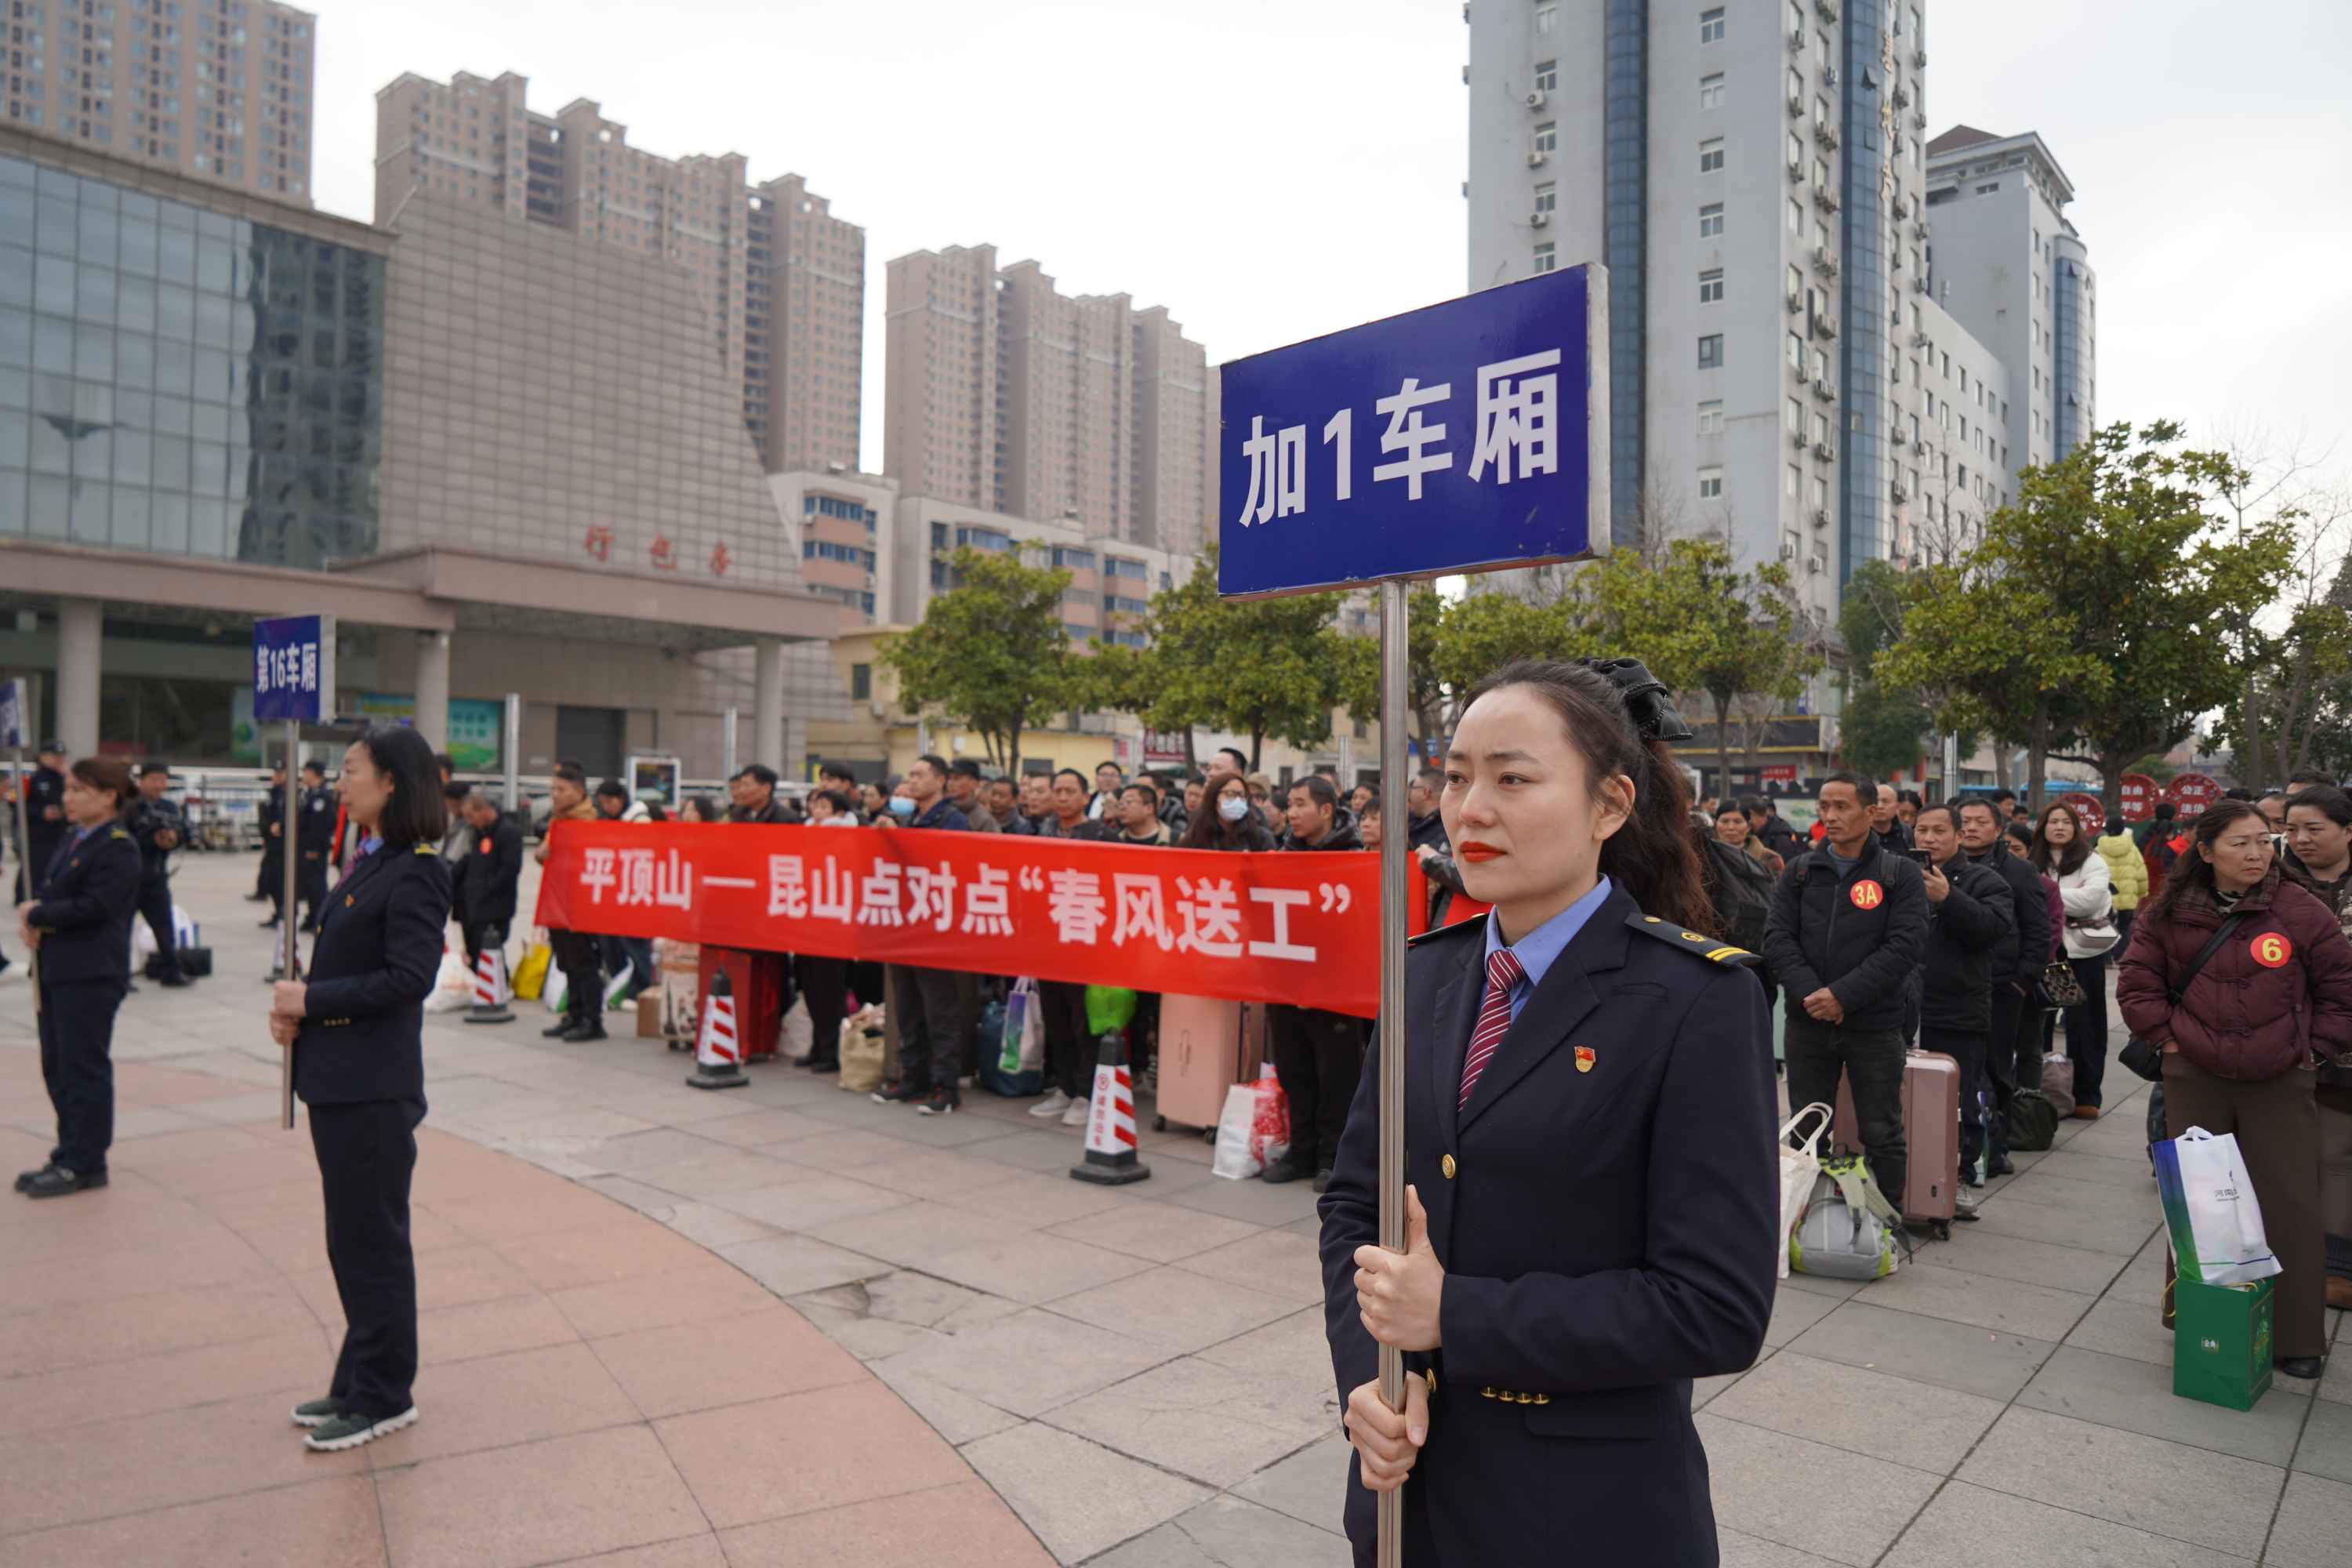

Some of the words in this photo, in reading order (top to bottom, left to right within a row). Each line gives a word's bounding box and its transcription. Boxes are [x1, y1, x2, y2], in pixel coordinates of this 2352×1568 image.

[1239, 348, 1561, 528] 加1车厢
[257, 641, 317, 693] 第16车厢
[2122, 785, 2143, 796] 自由
[2181, 785, 2205, 796] 公正
[2121, 801, 2143, 812] 平等
[2180, 803, 2205, 814] 法治
[1855, 884, 1878, 905] 3A
[2263, 938, 2282, 961] 6
